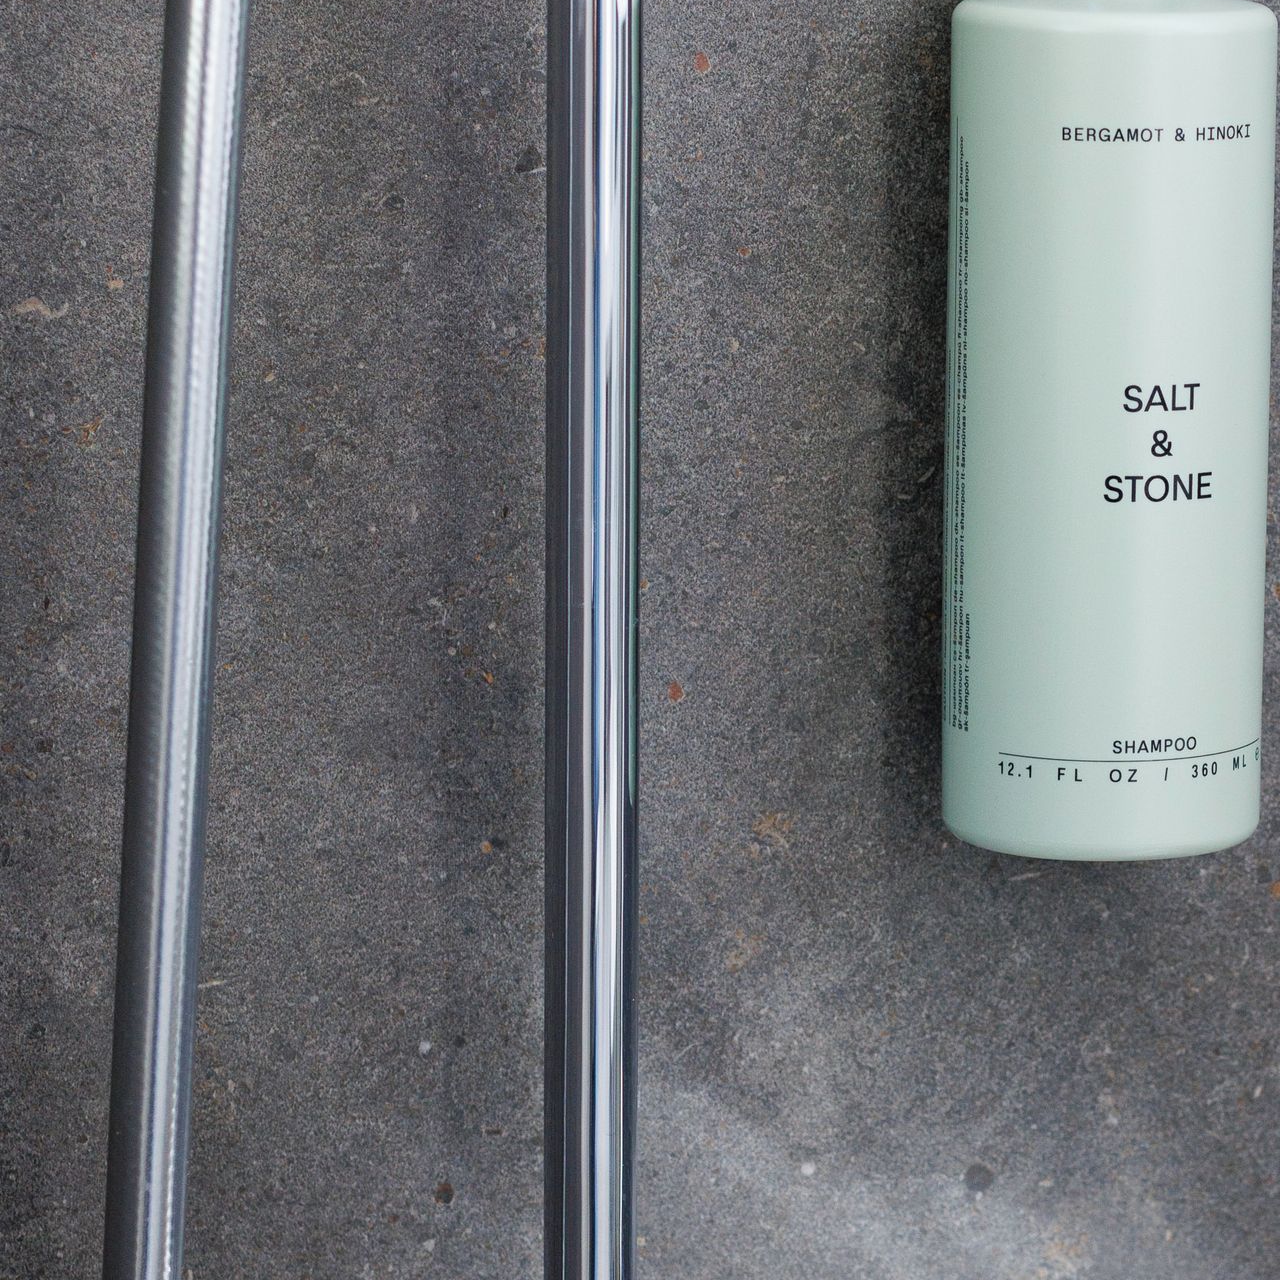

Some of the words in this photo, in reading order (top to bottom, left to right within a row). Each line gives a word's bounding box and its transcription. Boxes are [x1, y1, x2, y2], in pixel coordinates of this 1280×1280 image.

[1062, 127, 1164, 142] BERGAMOT
[1175, 128, 1185, 142] &
[1196, 124, 1250, 141] HINOKI
[1123, 383, 1200, 413] SALT
[1151, 430, 1173, 457] &
[1103, 472, 1212, 503] STONE
[1112, 736, 1197, 754] SHAMPOO
[998, 760, 1032, 778] 12.1
[1058, 767, 1082, 782] FL
[1109, 769, 1137, 783] OZ
[1164, 767, 1168, 781] /
[1191, 761, 1217, 778] 360
[1232, 754, 1246, 771] ML
